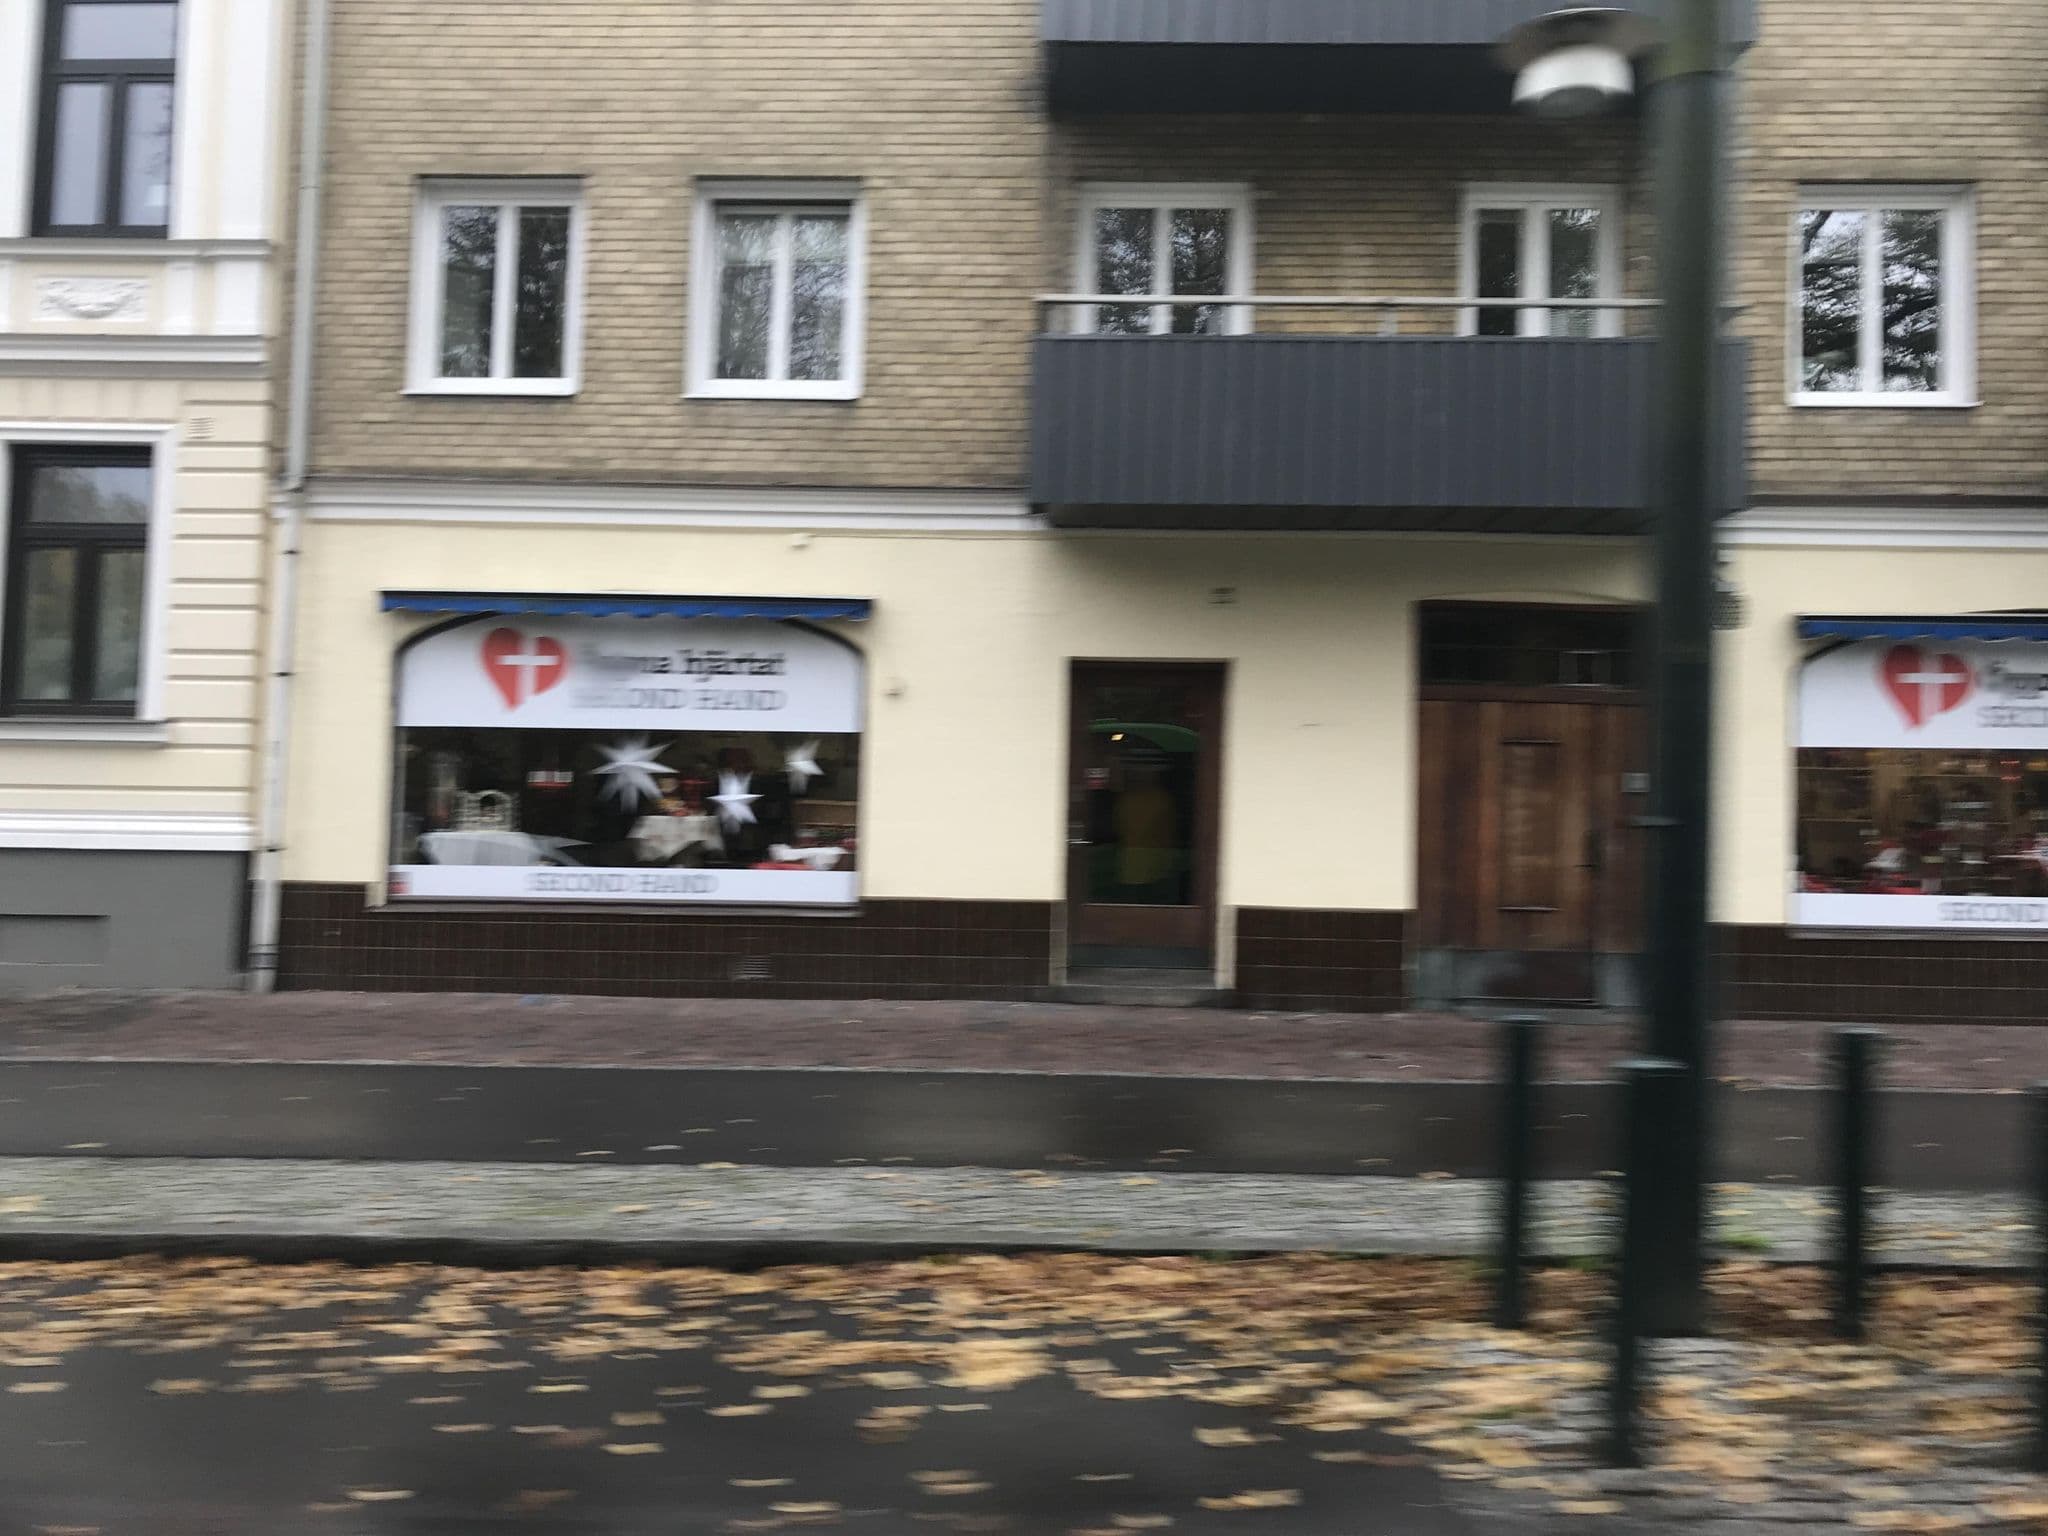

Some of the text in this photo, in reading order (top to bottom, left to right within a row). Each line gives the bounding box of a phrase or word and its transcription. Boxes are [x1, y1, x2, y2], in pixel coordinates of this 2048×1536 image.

[569, 688, 789, 711] OND HAND
[526, 872, 719, 894] SECOND HAND
